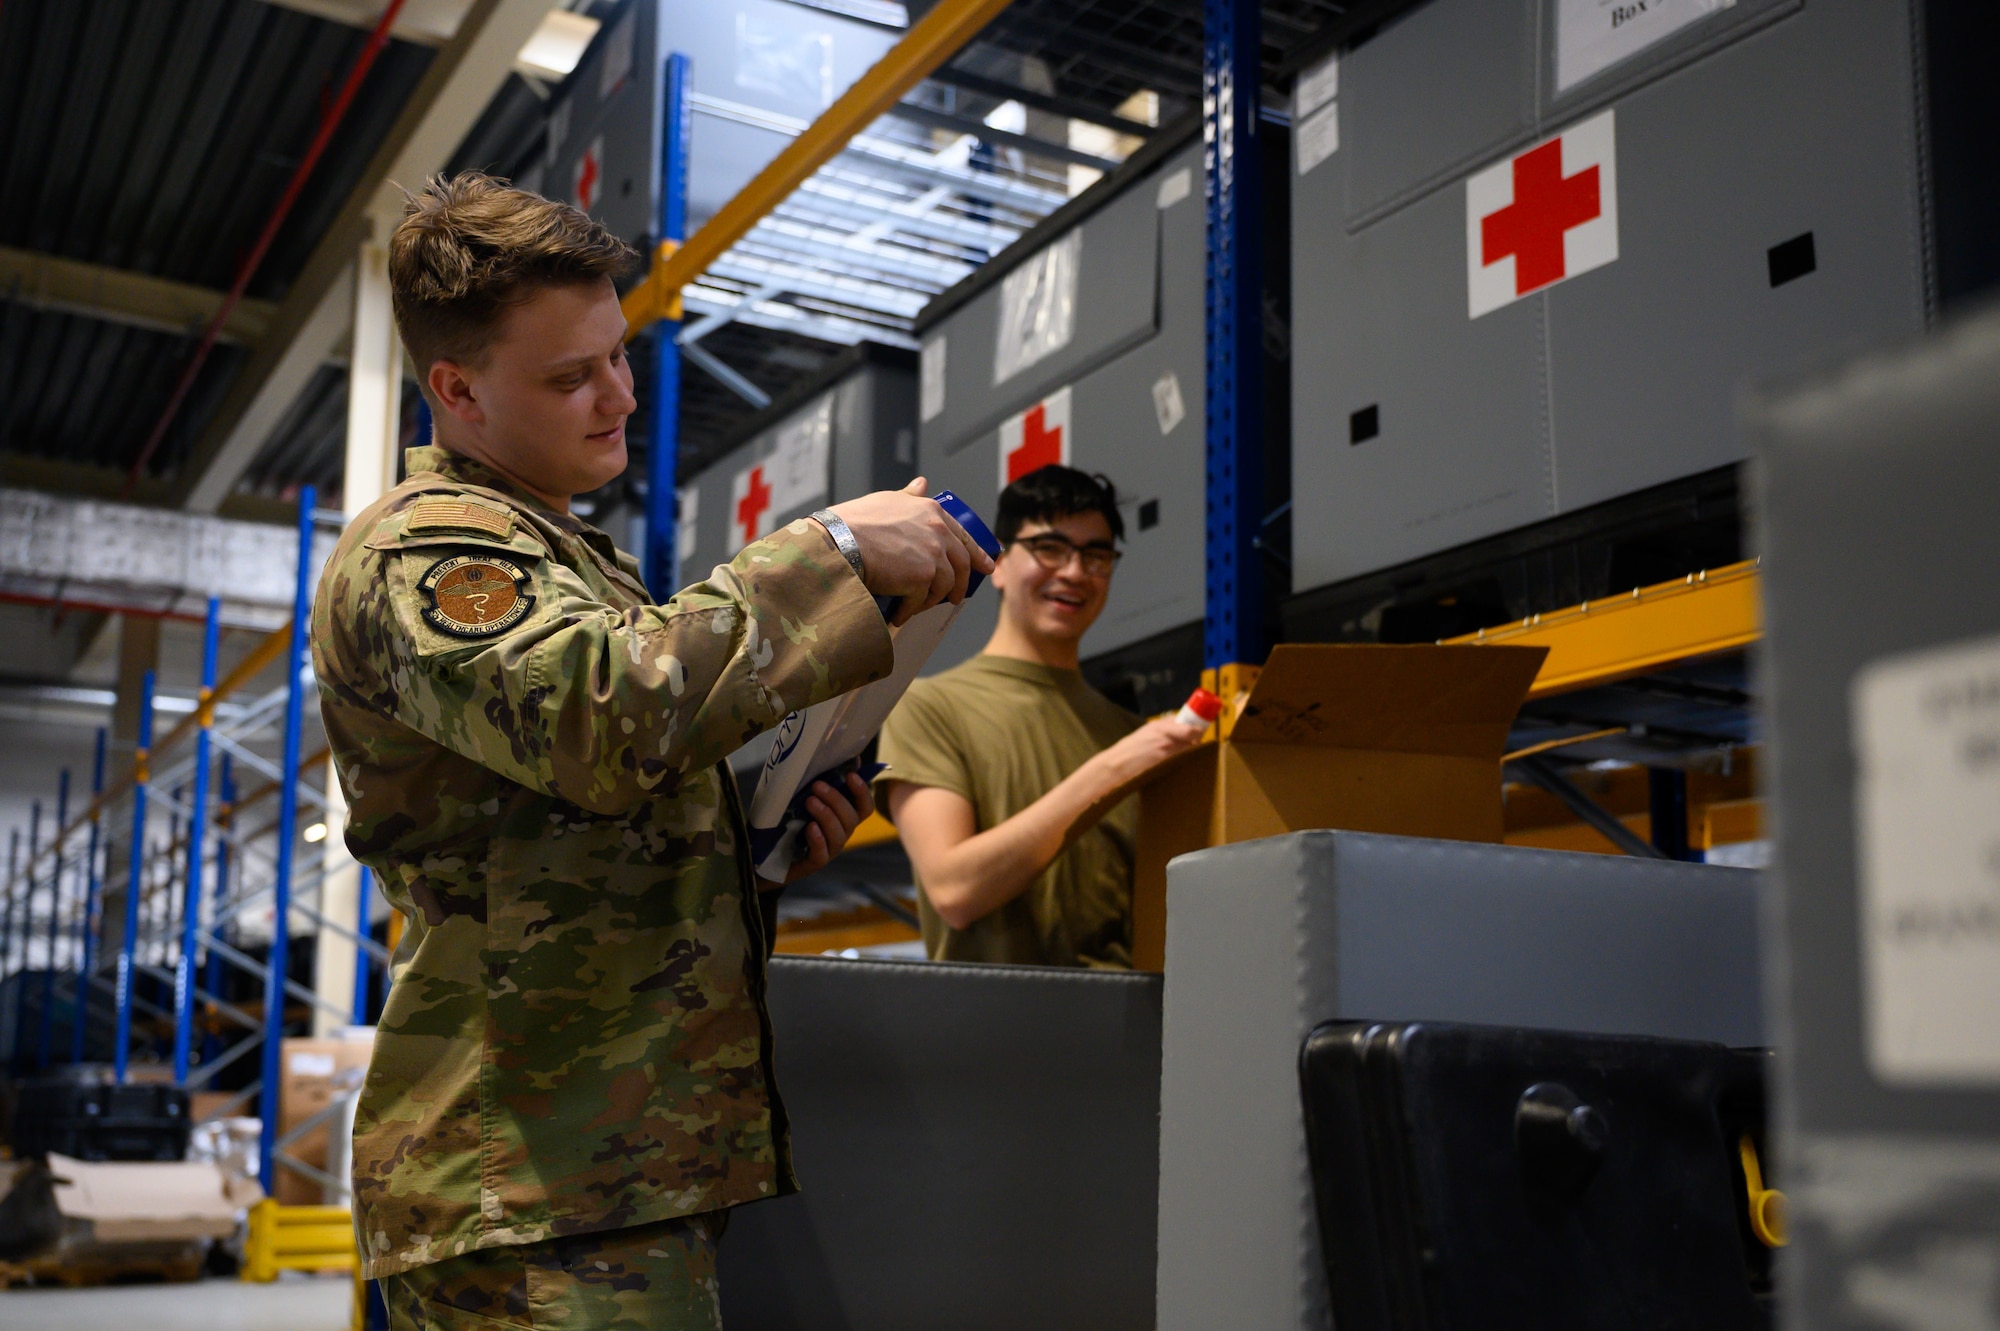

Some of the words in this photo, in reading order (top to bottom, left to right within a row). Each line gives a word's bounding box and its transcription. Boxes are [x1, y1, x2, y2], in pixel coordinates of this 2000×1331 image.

[1612, 0, 1647, 28] Box
[431, 560, 459, 580] PREVENT
[499, 560, 515, 572] HEAL
[440, 618, 484, 634] HEALTHCARE
[485, 605, 524, 633] OPERATIONS
